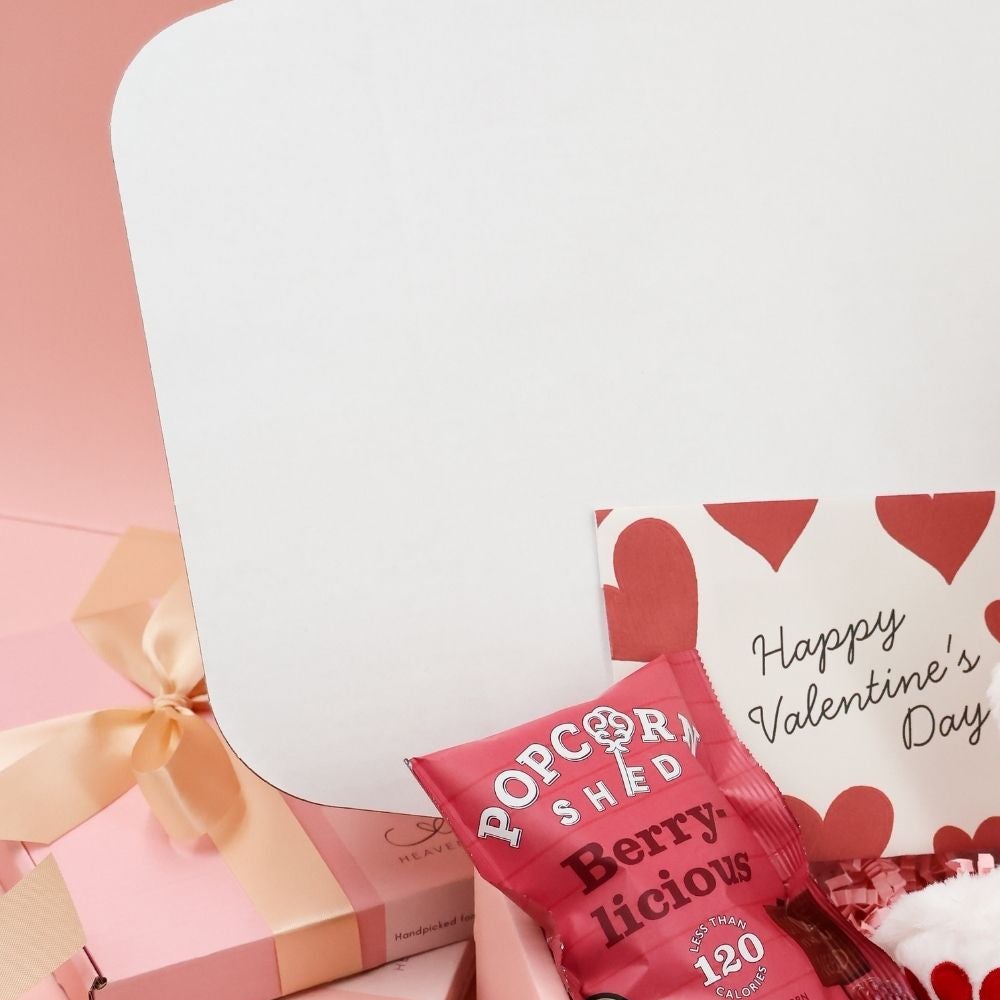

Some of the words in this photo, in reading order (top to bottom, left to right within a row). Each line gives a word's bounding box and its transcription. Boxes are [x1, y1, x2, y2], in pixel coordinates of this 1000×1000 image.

[752, 608, 906, 676] Happy
[748, 634, 980, 743] Valentine's
[903, 702, 991, 749] Day
[477, 706, 702, 849] POPCORN
[552, 754, 683, 826] SHED
[394, 916, 457, 941] Handpicked
[590, 851, 752, 949] licious
[689, 924, 709, 953] LESS
[709, 915, 748, 930] THAN
[693, 933, 766, 987] 120
[716, 965, 768, 1000] CALORIES
